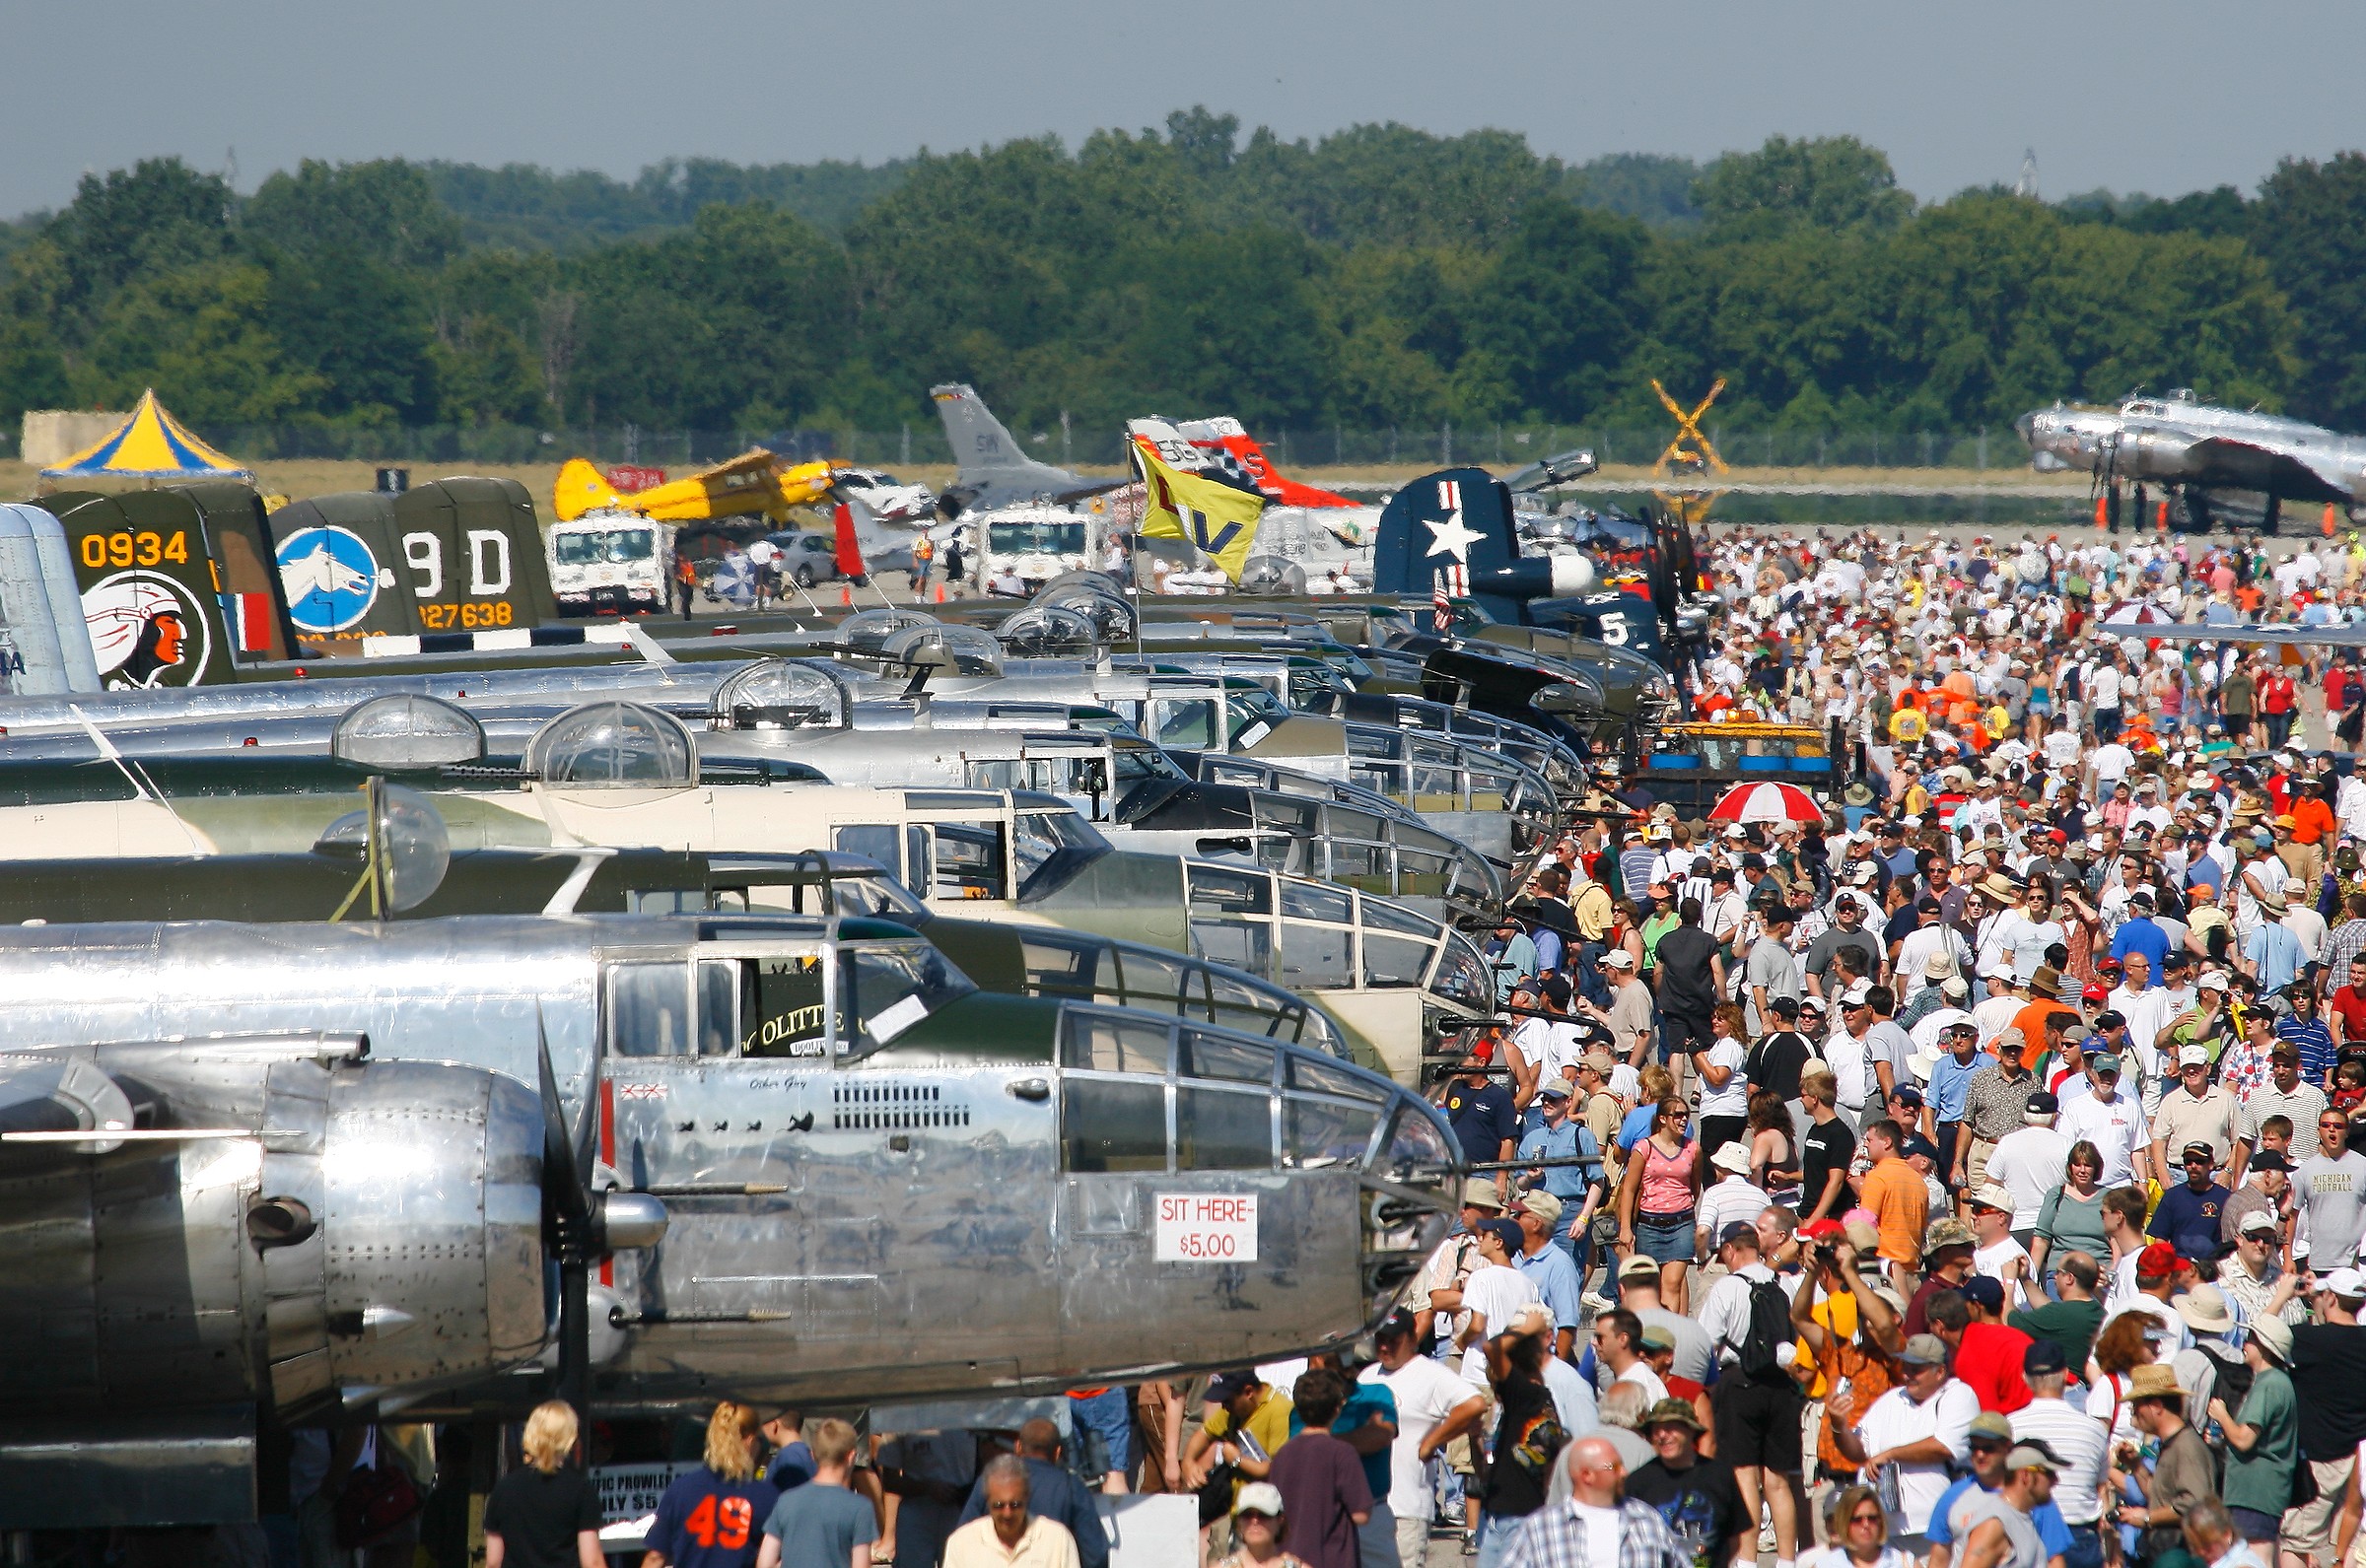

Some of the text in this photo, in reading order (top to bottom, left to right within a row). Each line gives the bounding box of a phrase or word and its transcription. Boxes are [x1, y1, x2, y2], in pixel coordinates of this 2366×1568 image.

[82, 530, 188, 568] 0934
[402, 529, 512, 598] 9 D
[1598, 611, 1630, 647] 5
[2312, 1183, 2353, 1193] FOOTBALL
[2313, 1173, 2352, 1184] MICHIGAN
[1161, 1197, 1190, 1221] SIT
[1180, 1233, 1235, 1258] $5.00
[685, 1493, 753, 1550] 49
